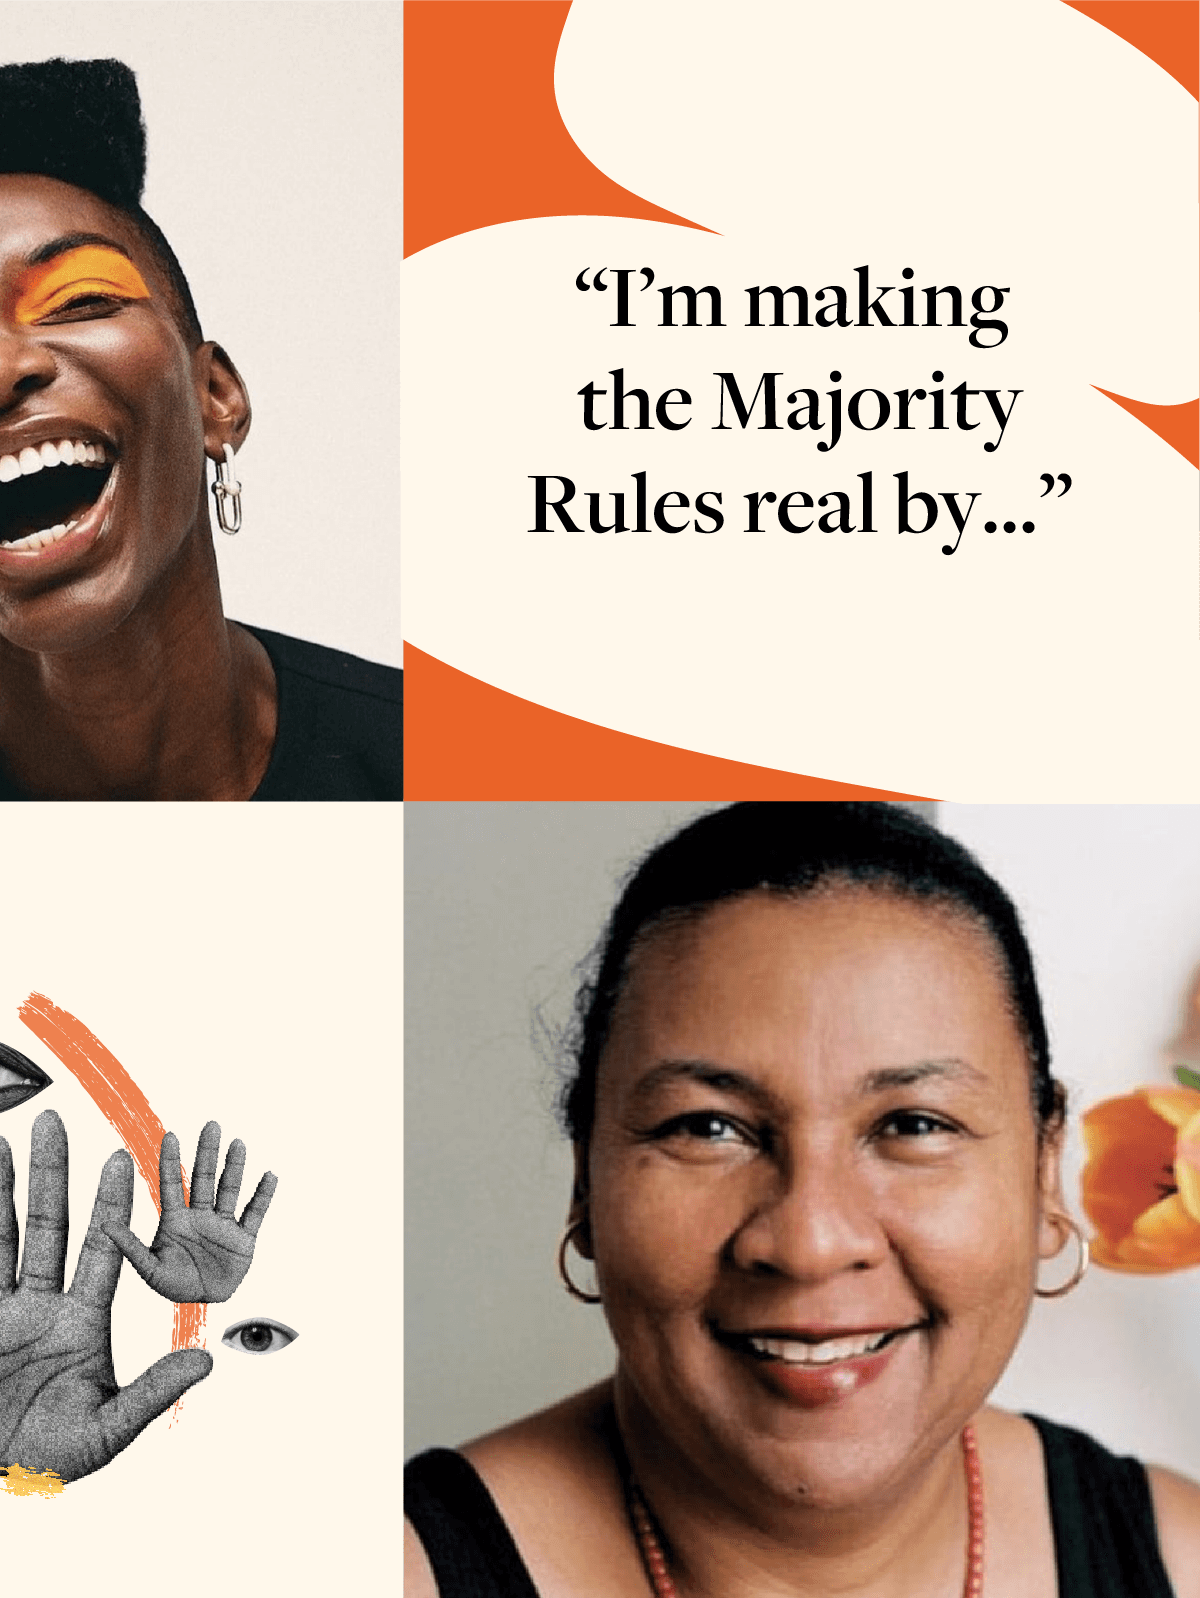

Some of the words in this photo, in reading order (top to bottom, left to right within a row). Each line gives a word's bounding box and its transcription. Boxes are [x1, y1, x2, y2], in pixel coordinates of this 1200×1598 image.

[744, 265, 1010, 348] making
[577, 368, 692, 431] the
[712, 371, 1024, 452] Majority
[528, 471, 725, 534] Rules
[743, 471, 878, 534] real
